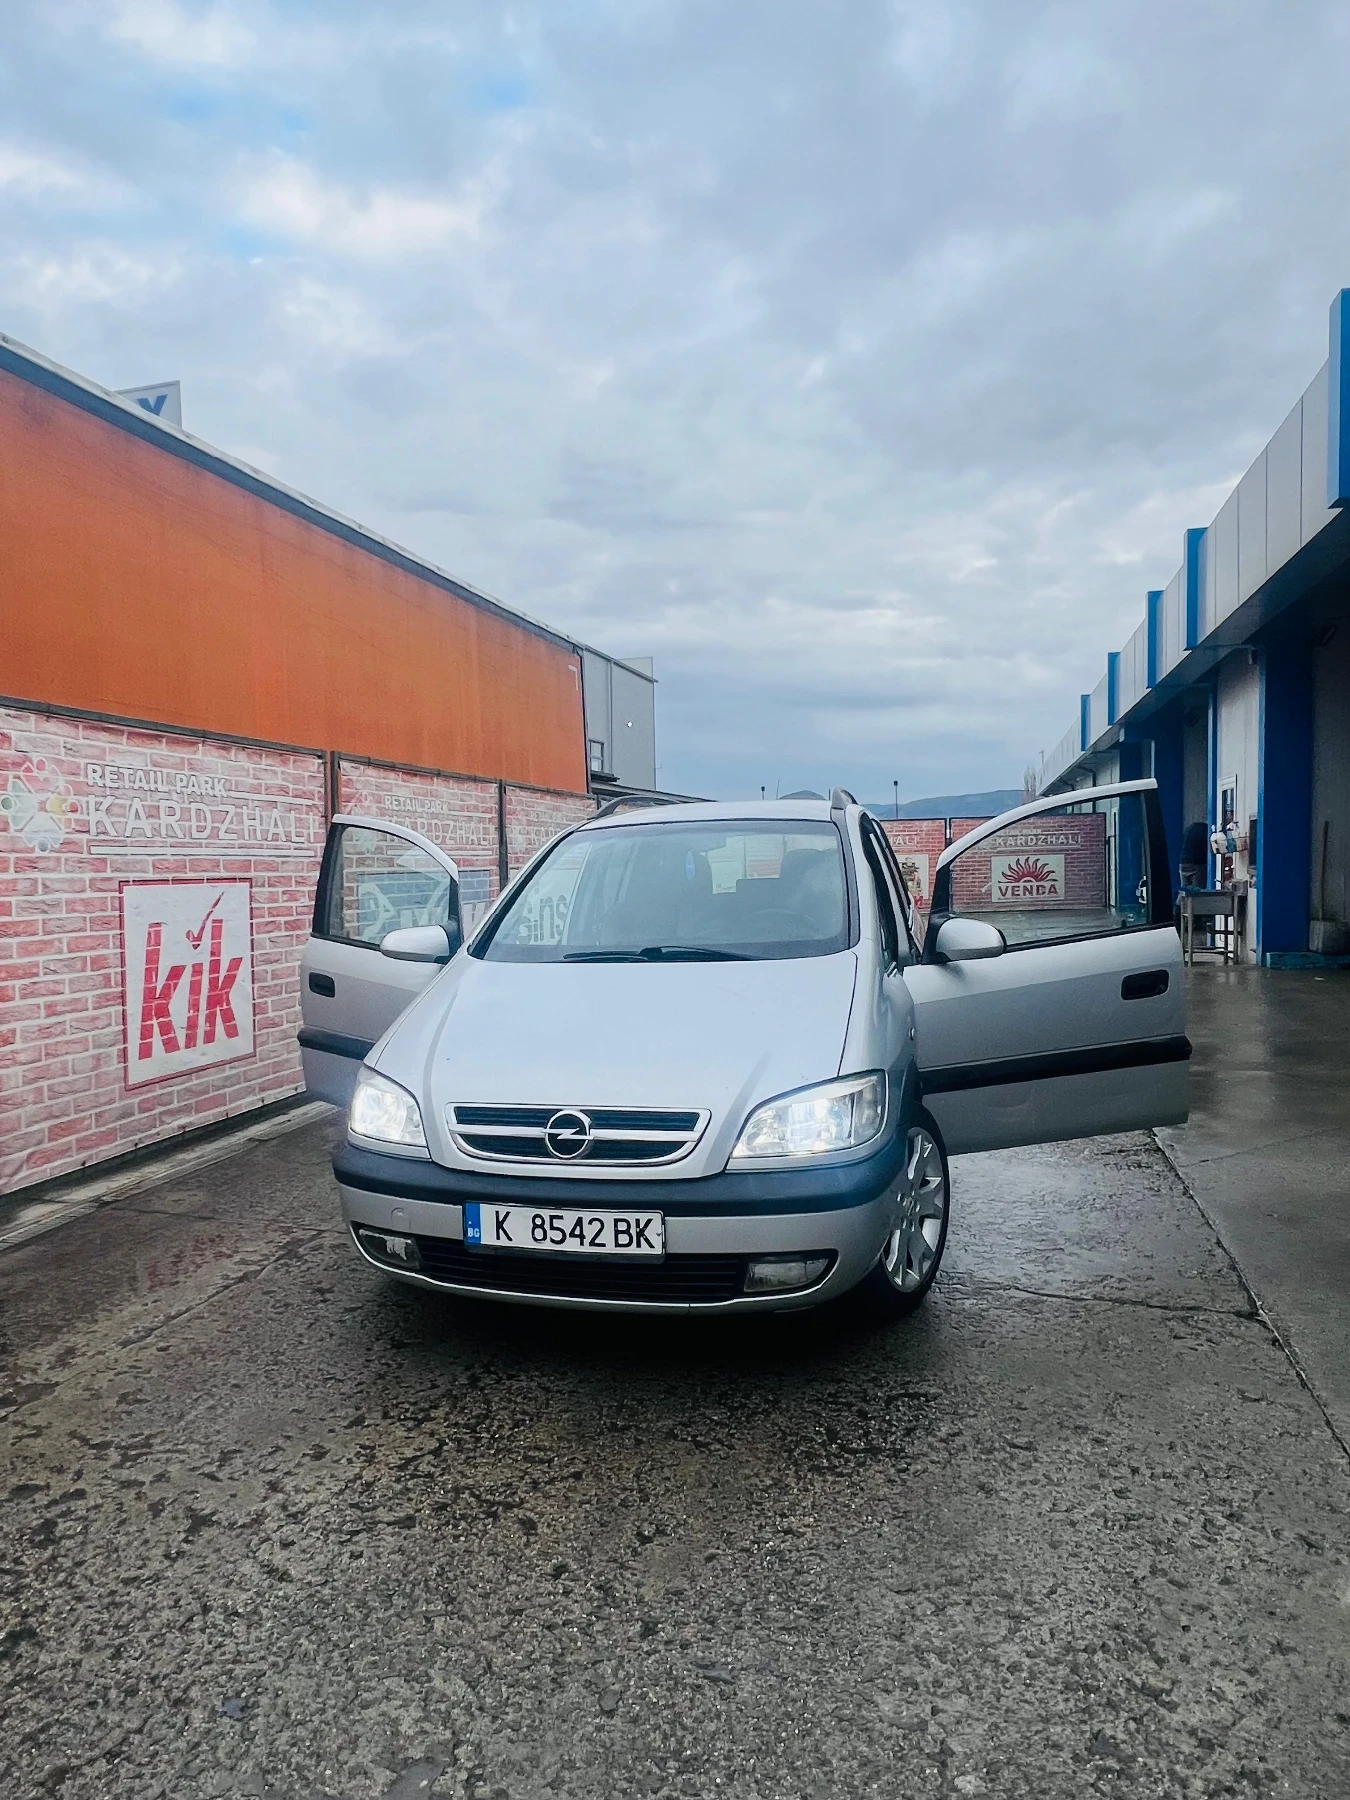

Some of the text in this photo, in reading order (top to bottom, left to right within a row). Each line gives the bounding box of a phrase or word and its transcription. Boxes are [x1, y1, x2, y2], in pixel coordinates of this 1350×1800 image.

[87, 763, 229, 798] RETAIL PARK
[384, 795, 449, 815] RETAIL PARK
[87, 795, 315, 844] KARDZHALI
[996, 834, 1081, 847] KARDZHALI
[998, 883, 1059, 897] VENDA
[467, 1227, 481, 1239] BG
[495, 1210, 513, 1242] K
